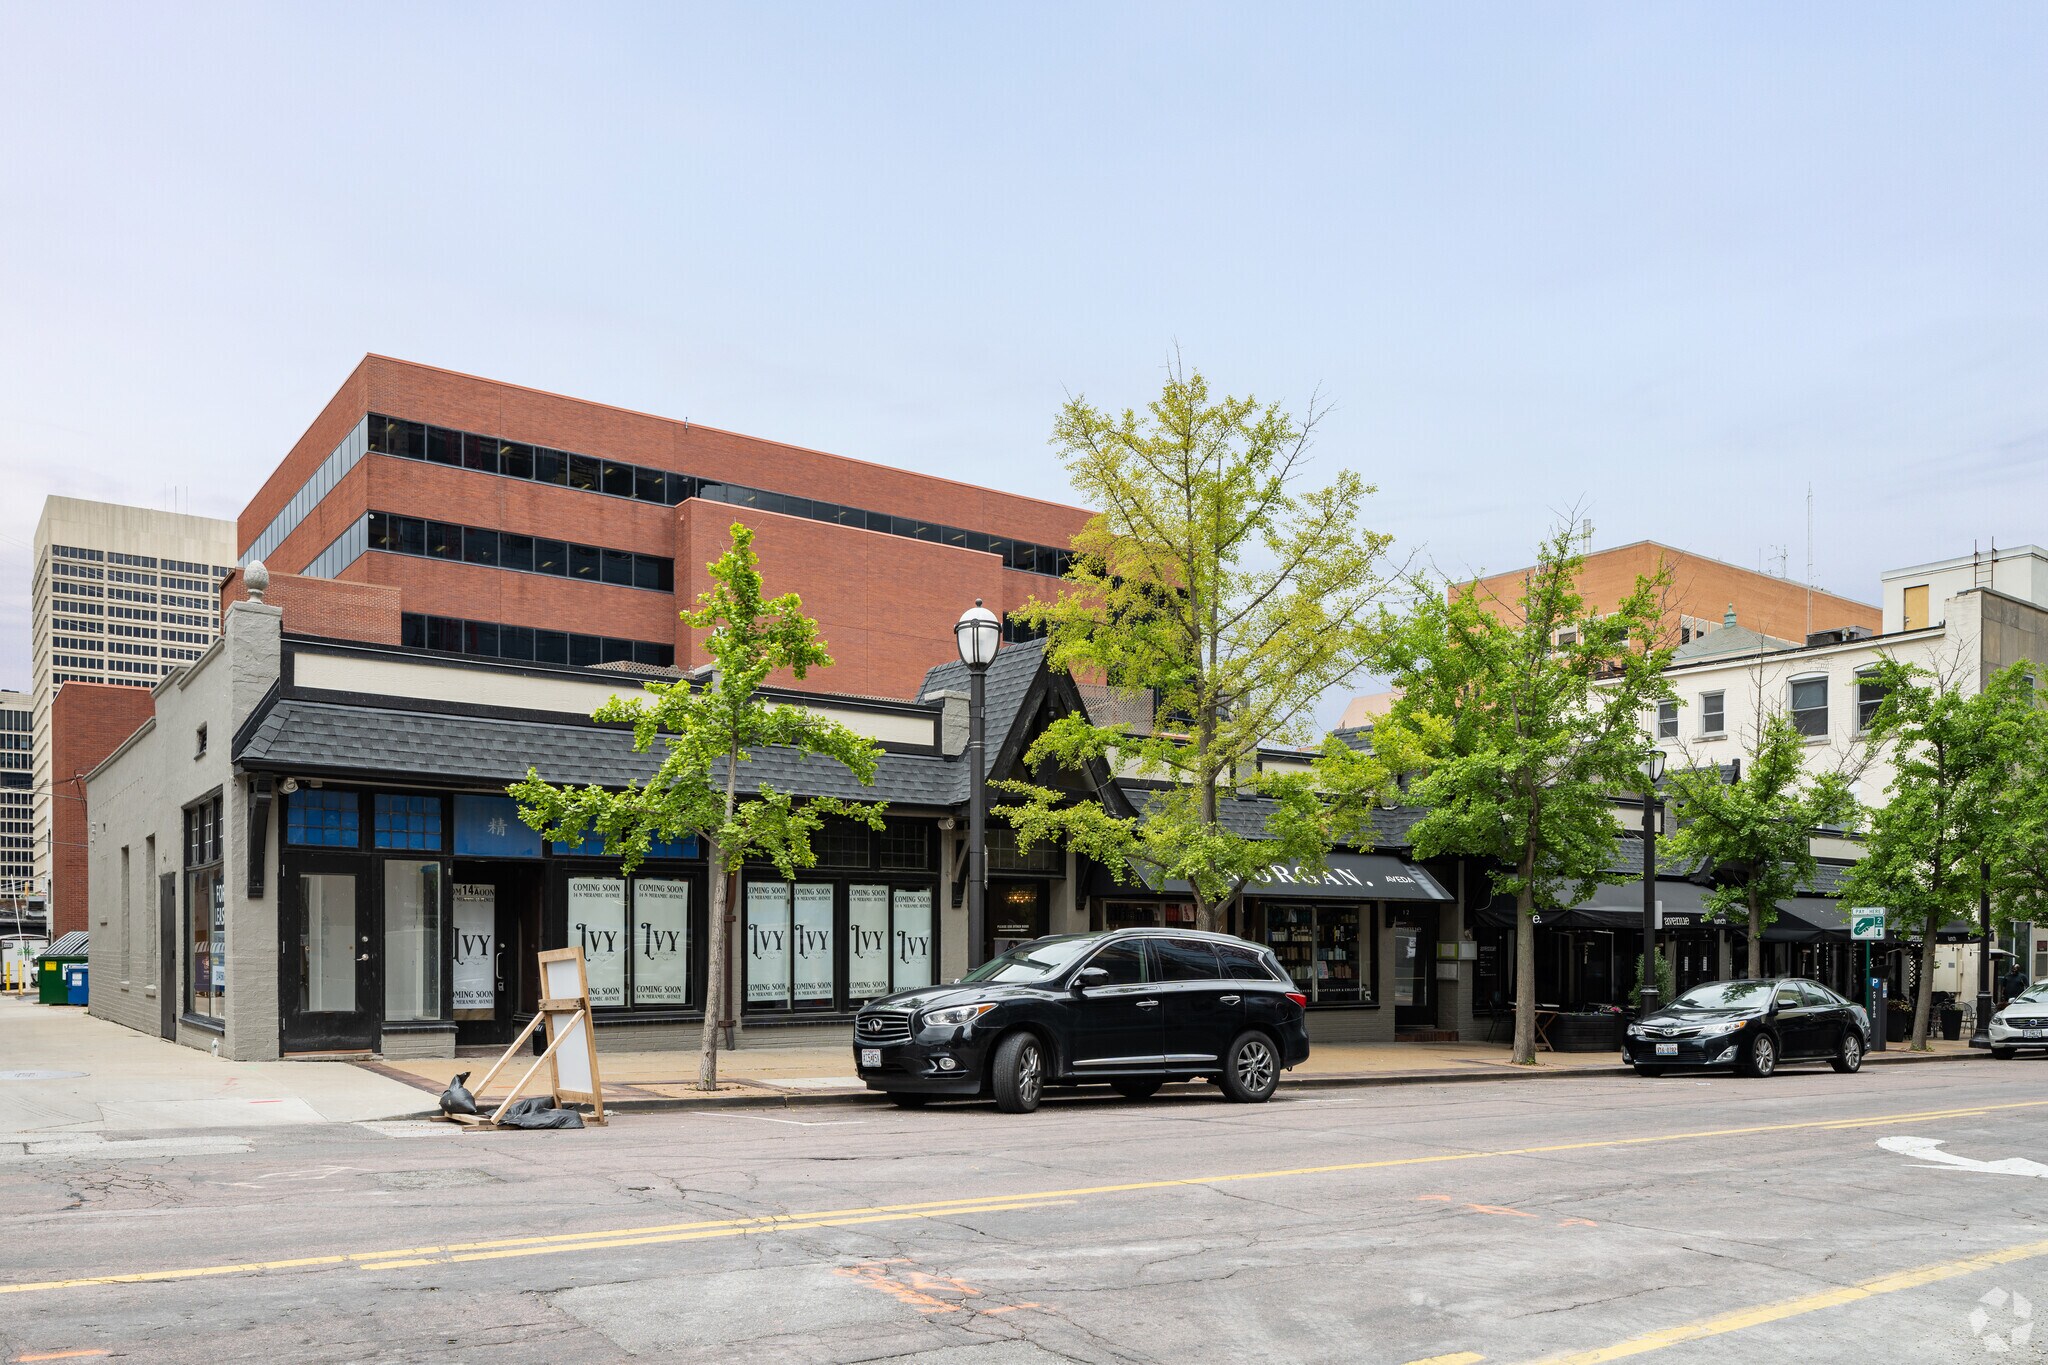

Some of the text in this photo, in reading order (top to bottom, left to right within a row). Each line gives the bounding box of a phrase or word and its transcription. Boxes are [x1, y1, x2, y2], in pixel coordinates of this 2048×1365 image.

[488, 818, 508, 836] 精
[1385, 875, 1415, 883] AVEDA
[573, 883, 621, 892] COMING SOON
[639, 883, 684, 893] COMING SOON
[894, 895, 915, 903] COMING
[215, 907, 225, 925] LEAS
[1664, 916, 1690, 926] avenue
[1872, 978, 1879, 987] P
[588, 987, 620, 995] ING SOON
[636, 985, 682, 993] COMING SOON
[453, 991, 474, 999] MING
